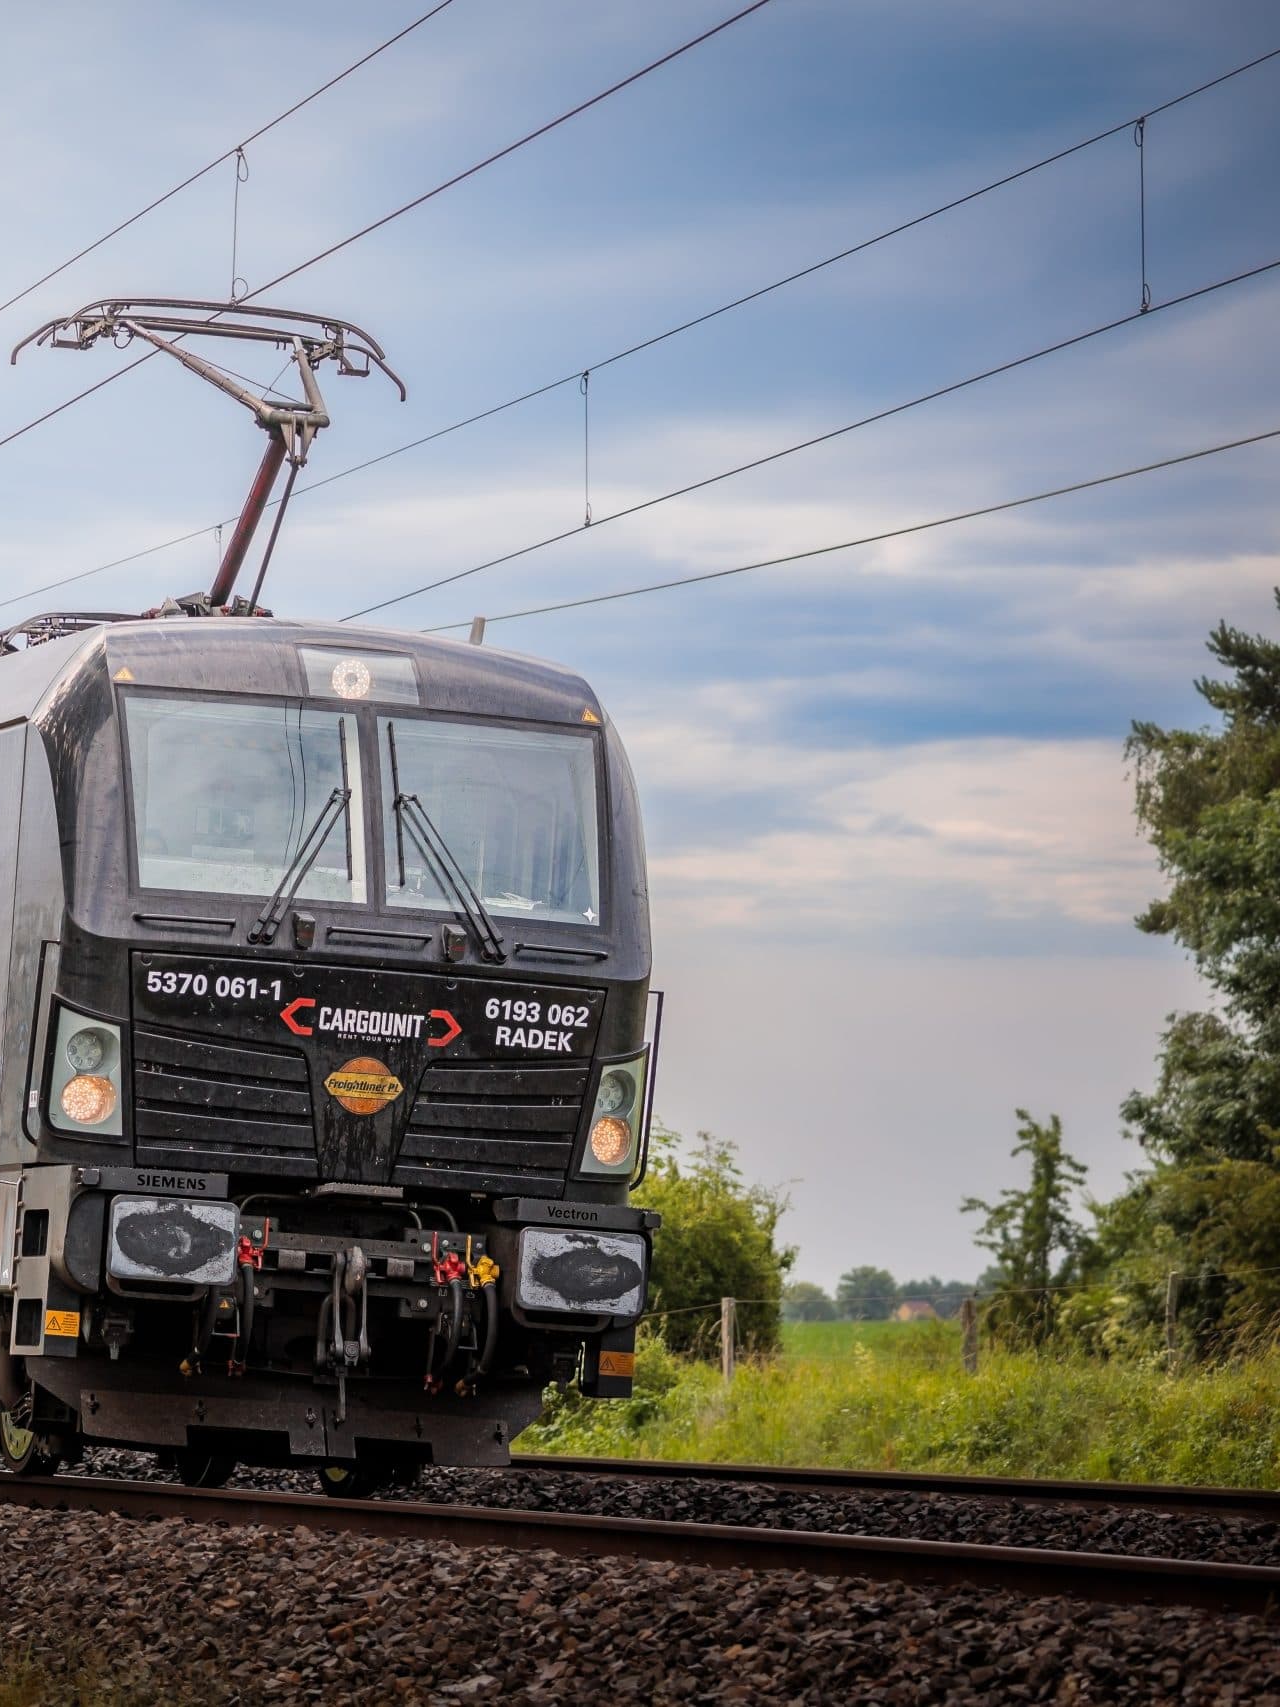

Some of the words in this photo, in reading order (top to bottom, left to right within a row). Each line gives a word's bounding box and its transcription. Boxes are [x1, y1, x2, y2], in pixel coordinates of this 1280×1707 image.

[147, 971, 208, 996] 5370
[215, 976, 282, 1001] 061-1
[318, 1006, 425, 1039] CARGOUNIT
[485, 998, 541, 1023] 6193
[547, 1004, 589, 1028] 062
[361, 1035, 382, 1043] YOUR
[385, 1037, 402, 1045] WAY
[495, 1026, 574, 1052] RADEK
[327, 1077, 386, 1094] Freightliner
[387, 1083, 400, 1093] PL
[137, 1174, 206, 1191] SIEMENS
[547, 1206, 598, 1221] Vectron
